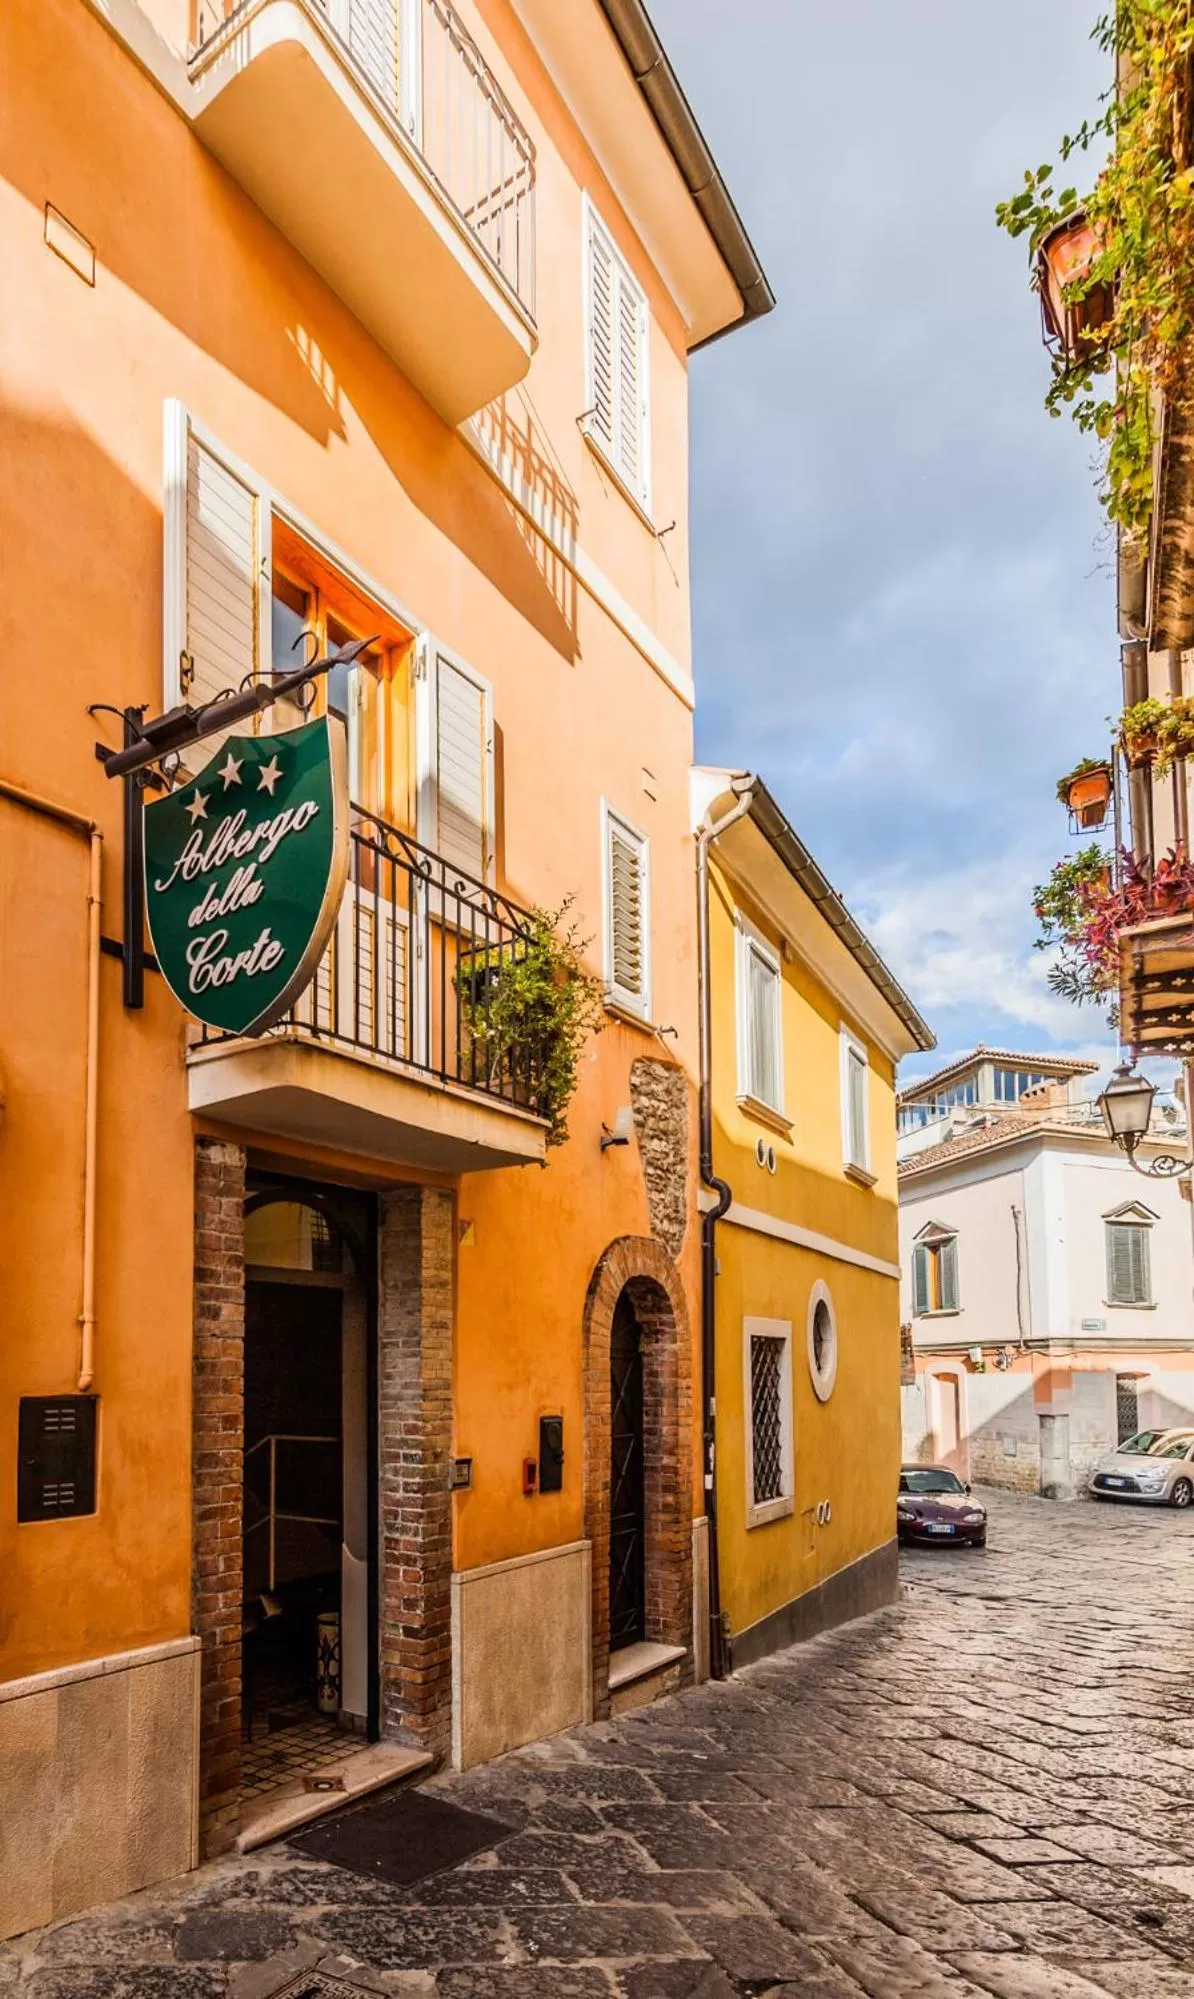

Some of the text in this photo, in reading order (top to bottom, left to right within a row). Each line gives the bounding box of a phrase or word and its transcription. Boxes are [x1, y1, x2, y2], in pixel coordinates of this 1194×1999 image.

[154, 800, 319, 892] Albergo
[187, 862, 265, 929] della
[185, 927, 286, 995] Corte
